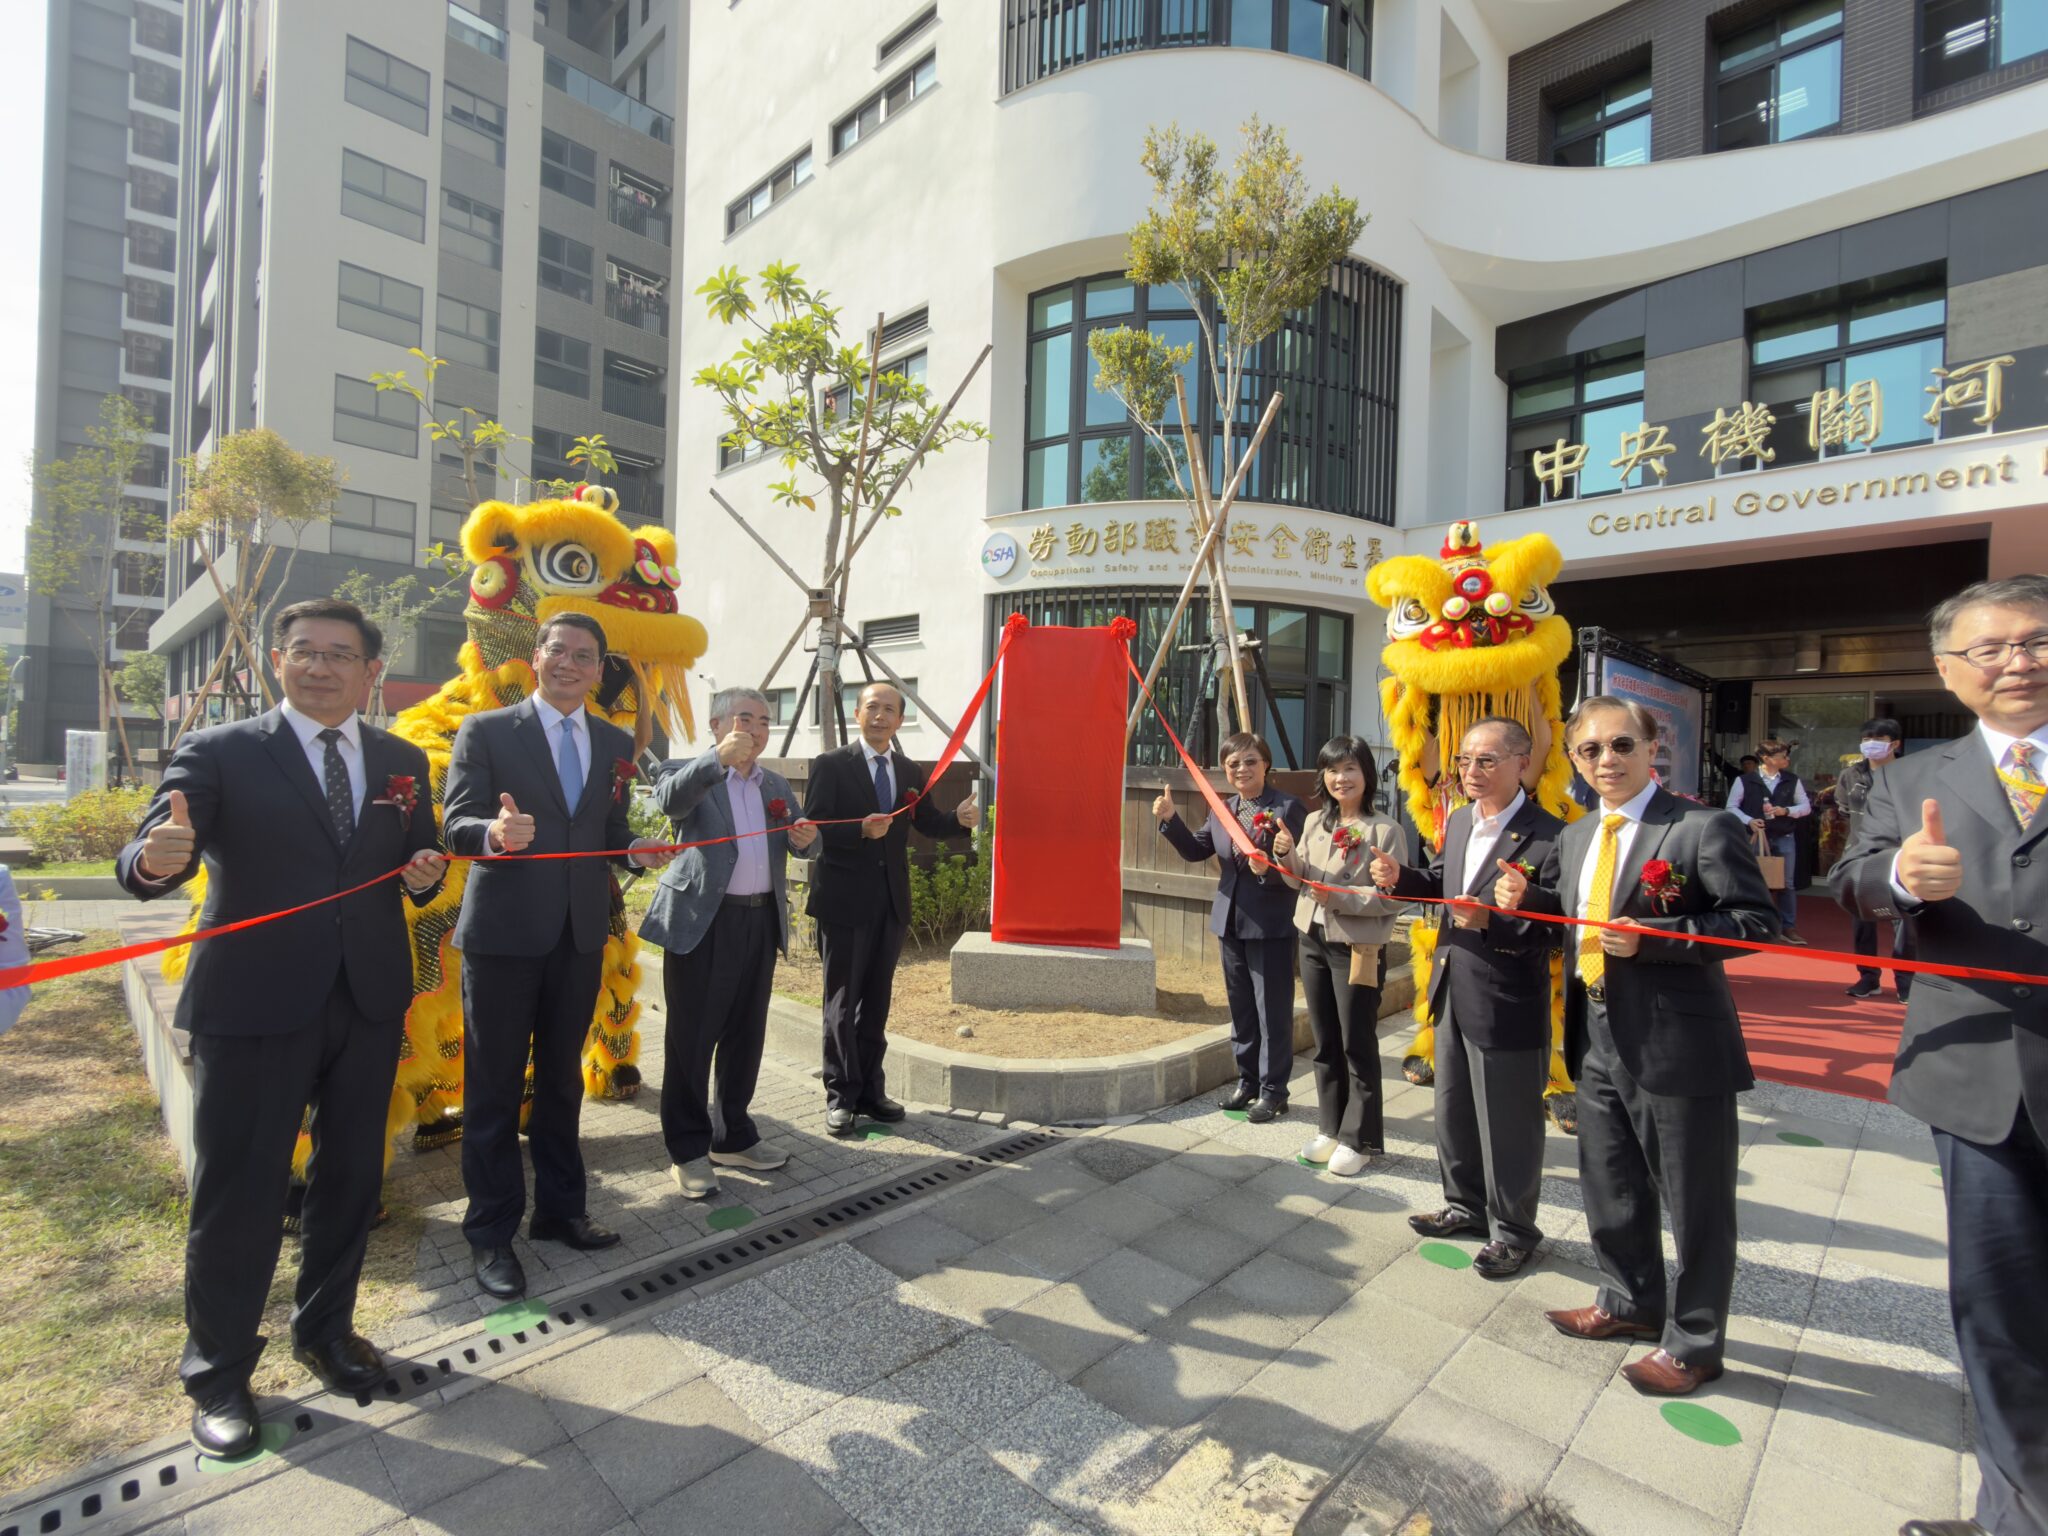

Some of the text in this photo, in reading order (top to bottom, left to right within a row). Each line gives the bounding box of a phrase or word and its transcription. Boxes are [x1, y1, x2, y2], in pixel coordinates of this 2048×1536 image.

[1587, 496, 1716, 536] Central
[1732, 453, 2014, 517] Government
[982, 545, 1015, 564] OSHA
[1030, 565, 1095, 578] Occupational
[1104, 563, 1139, 574] Safety
[1148, 563, 1169, 572] and
[1310, 570, 1344, 584] Ministry
[1350, 578, 1358, 586] of
